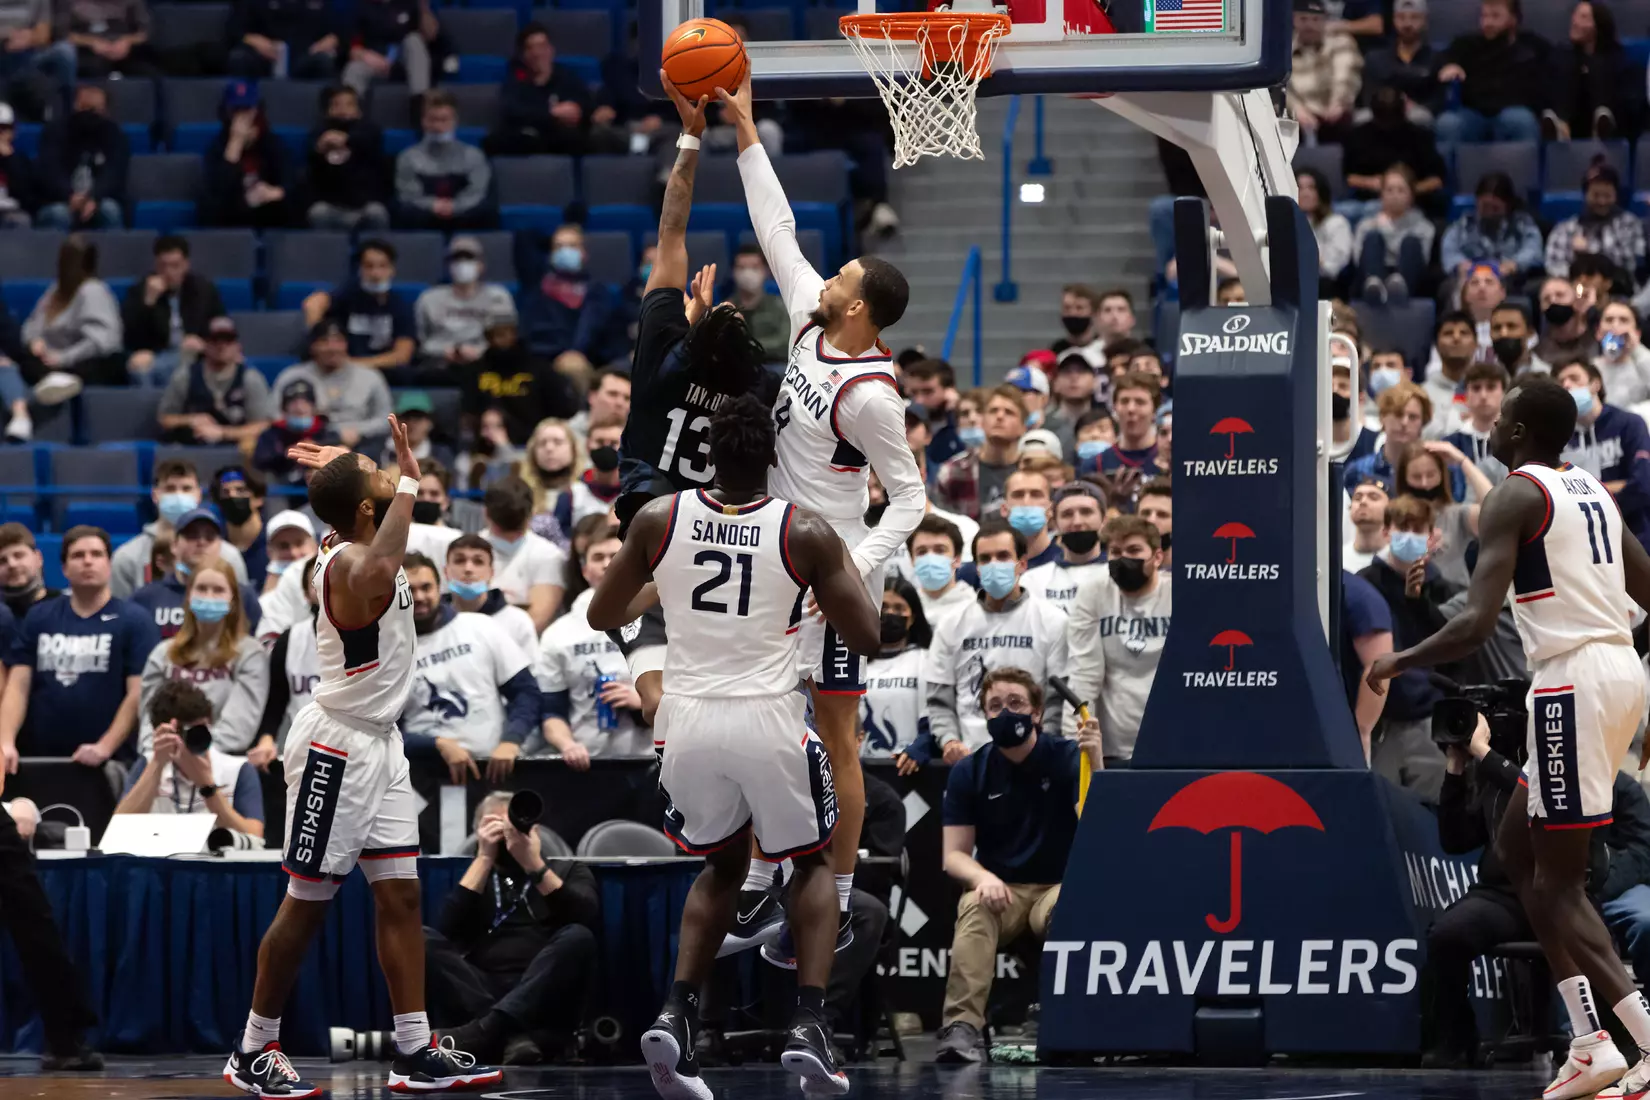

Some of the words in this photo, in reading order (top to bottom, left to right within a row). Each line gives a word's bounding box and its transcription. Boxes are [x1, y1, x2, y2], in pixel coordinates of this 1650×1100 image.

[1180, 331, 1288, 356] SPALDING
[657, 407, 717, 484] 13
[1183, 458, 1278, 476] TRAVELERS
[1560, 477, 1597, 495] AKOK
[691, 519, 761, 547] SANOGO
[1577, 501, 1614, 565] 11
[691, 550, 753, 616] 21
[1184, 564, 1280, 580] TRAVELERS
[430, 643, 472, 664] BUTLER
[962, 637, 989, 652] BEAT
[992, 635, 1033, 649] BUTLER
[1182, 671, 1278, 688] TRAVELERS
[1545, 702, 1569, 810] HUSKIES
[815, 745, 836, 829] HUSKIES
[295, 760, 333, 864] HUSKIES
[1042, 939, 1418, 995] TRAVELERS
